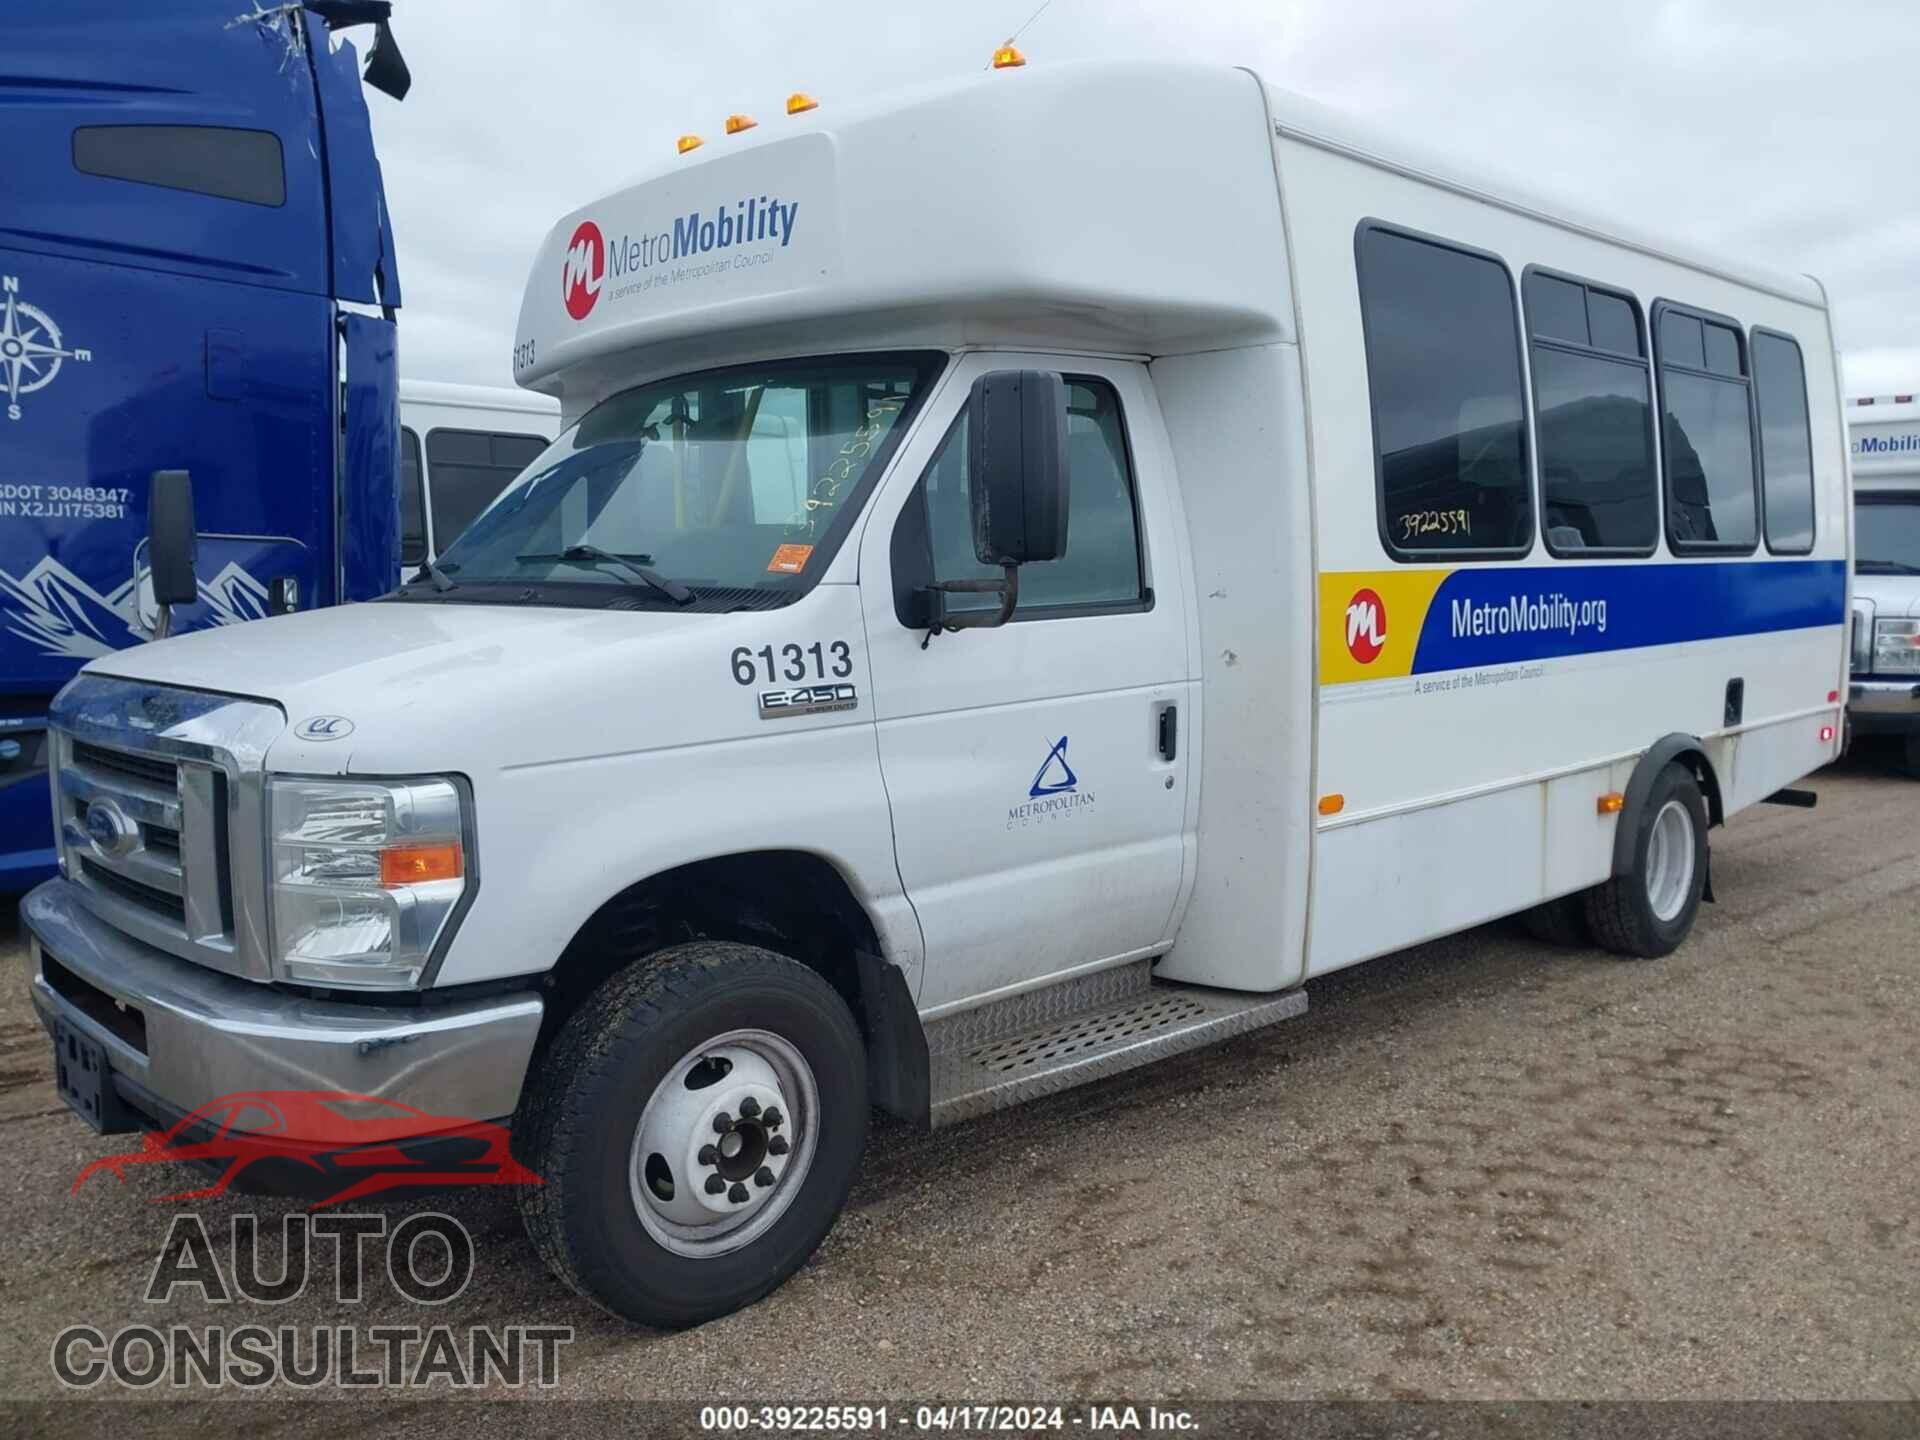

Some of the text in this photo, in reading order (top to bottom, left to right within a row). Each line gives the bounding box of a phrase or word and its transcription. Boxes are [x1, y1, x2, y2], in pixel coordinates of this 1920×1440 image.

[608, 196, 799, 280] MetroMobility
[3, 276, 19, 293] N
[615, 281, 642, 299] service
[654, 273, 669, 288] the
[670, 257, 731, 285] Metropolitan
[733, 248, 774, 270] Council
[75, 349, 91, 362] E
[8, 404, 21, 420] S
[48, 486, 128, 502] 3048347
[20, 502, 124, 519] X2JJ175381
[1400, 509, 1471, 540] 39225591
[1452, 594, 1607, 636] MetroMobility.org
[731, 640, 853, 686] 61313
[1414, 680, 1421, 695] A
[1423, 679, 1451, 694] service
[1452, 675, 1460, 689] of
[1461, 674, 1473, 688] the
[1008, 791, 1095, 820] METROPOLITAN
